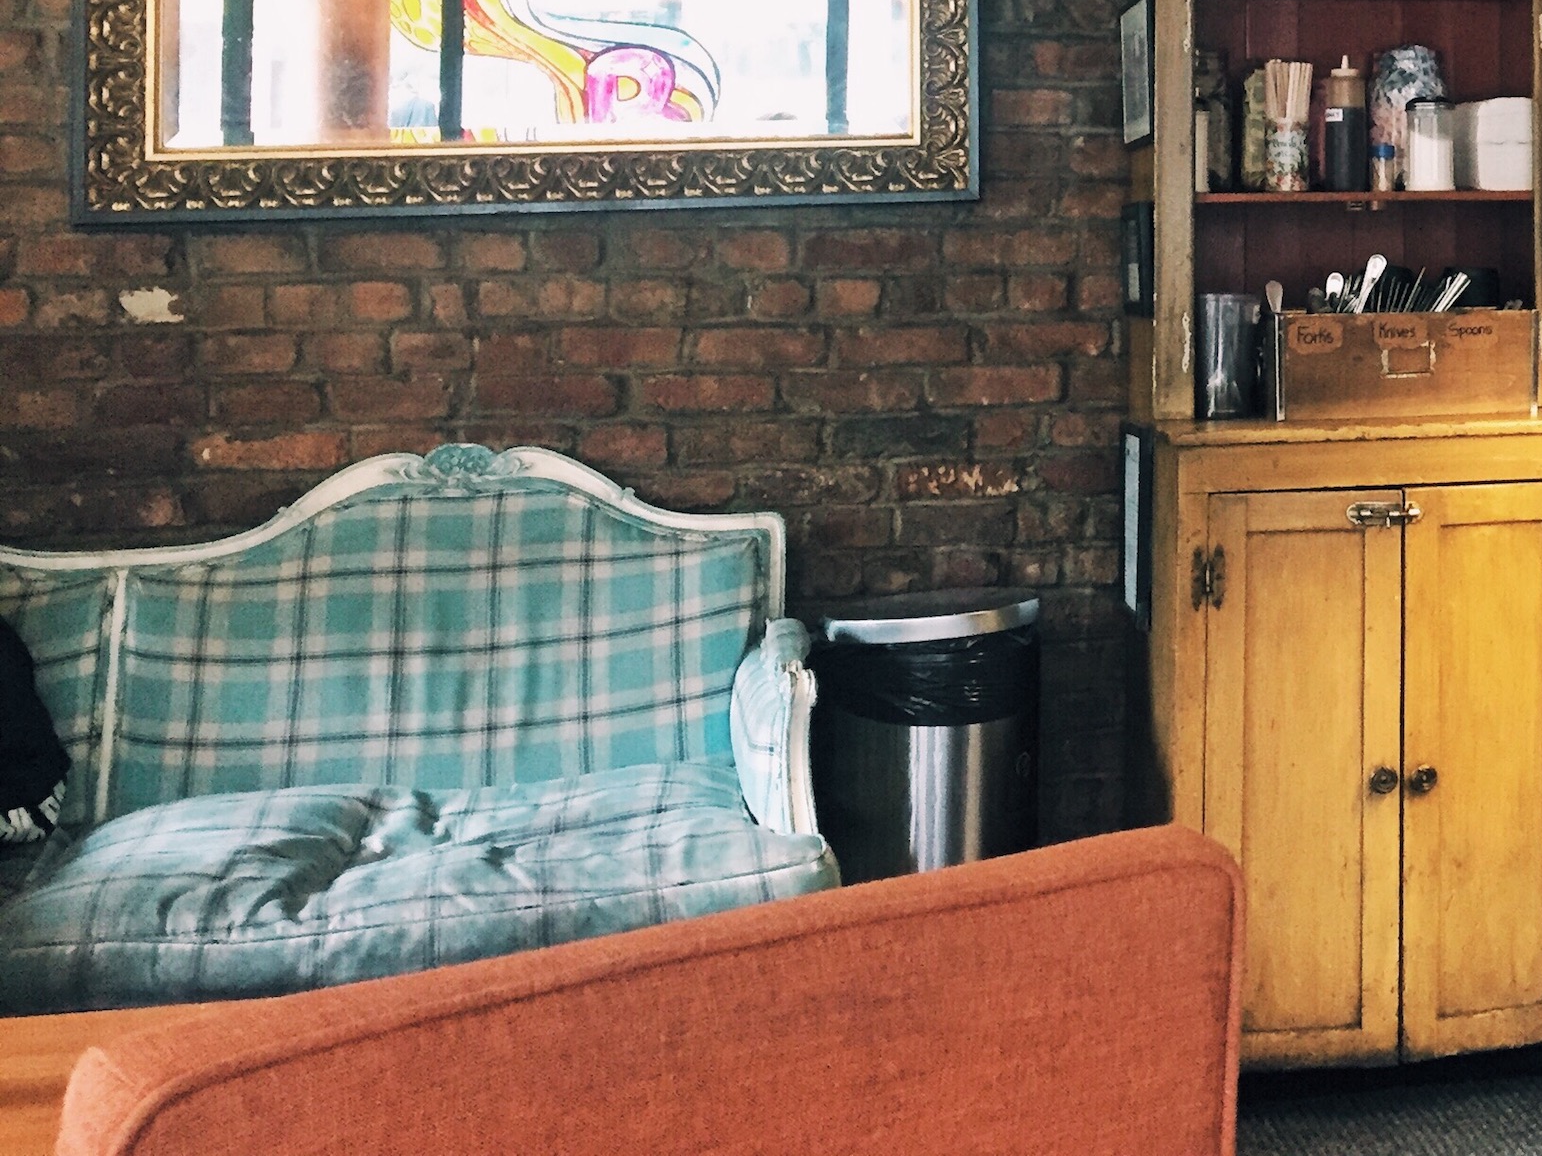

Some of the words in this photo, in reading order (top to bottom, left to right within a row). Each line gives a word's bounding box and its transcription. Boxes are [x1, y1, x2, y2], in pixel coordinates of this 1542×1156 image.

[1295, 325, 1336, 346] Forks
[1378, 322, 1417, 341] Knives
[1448, 323, 1494, 338] Spoons
